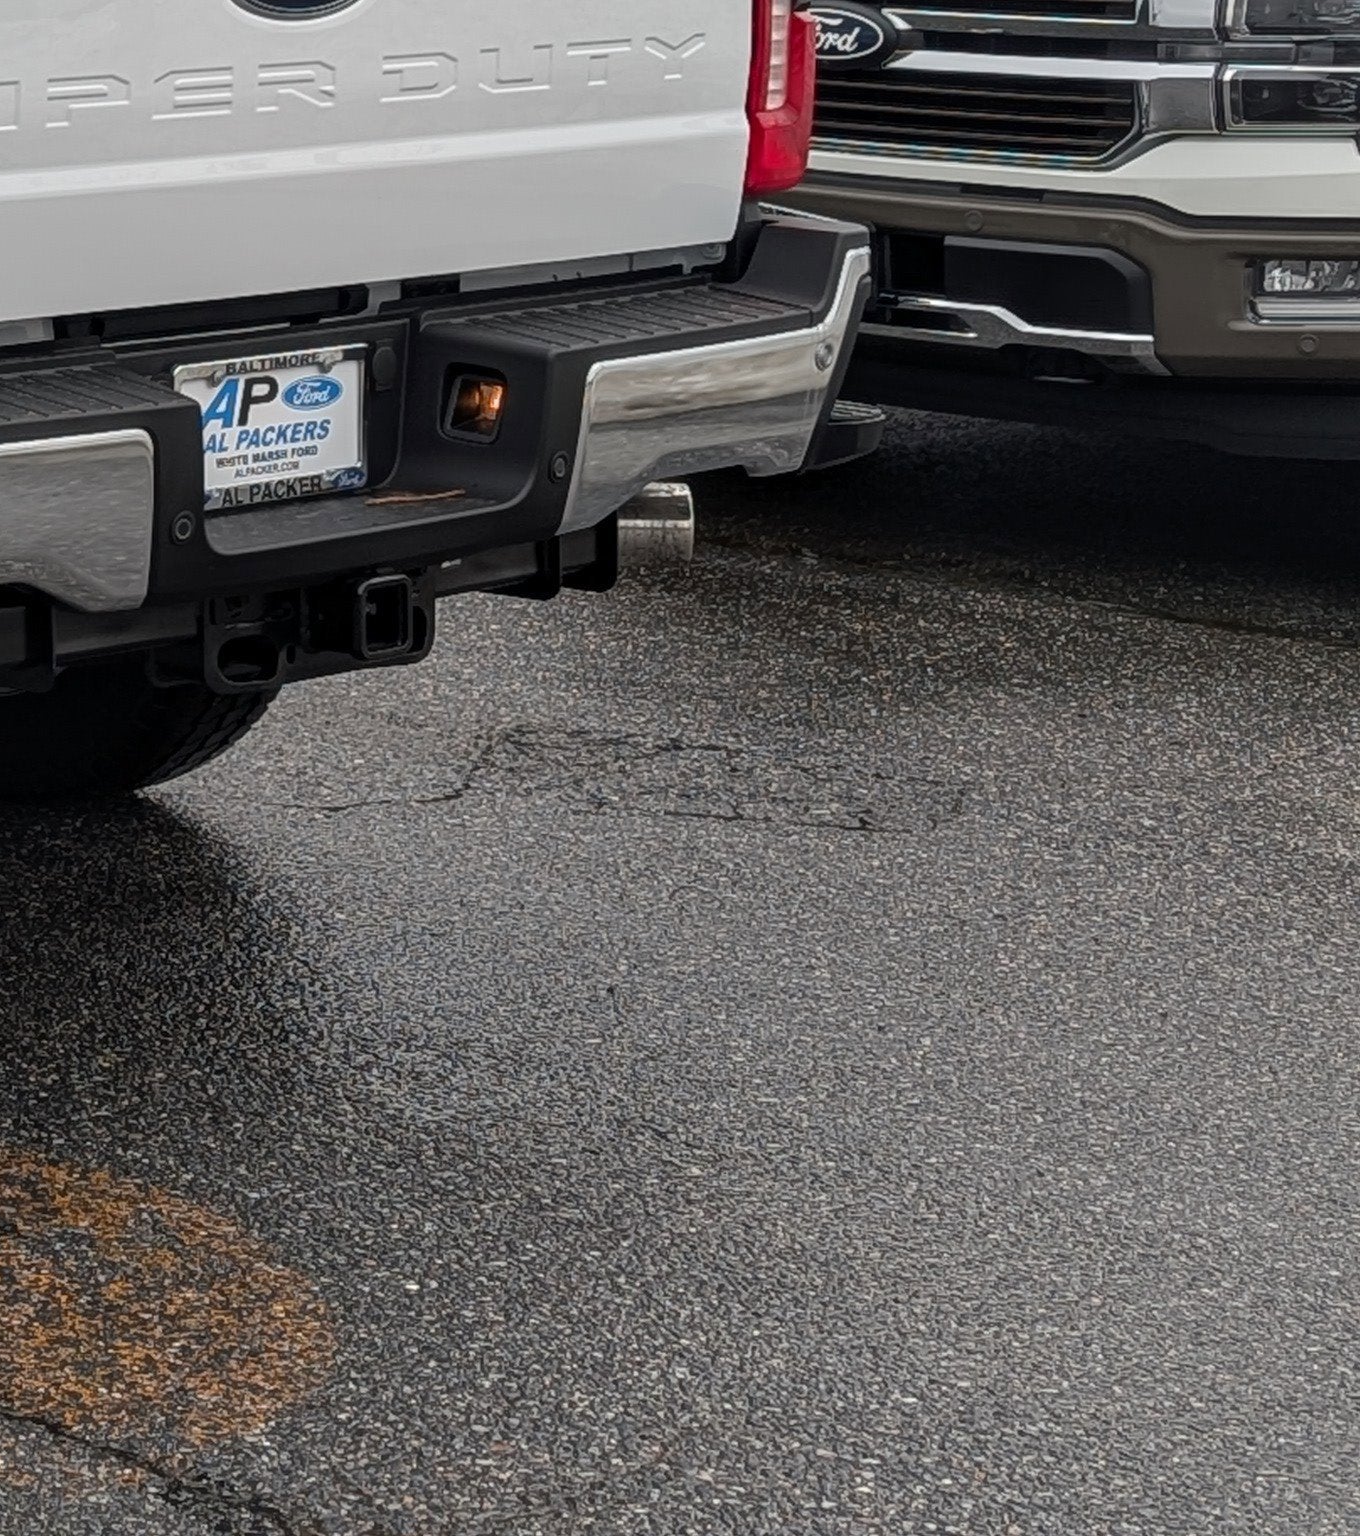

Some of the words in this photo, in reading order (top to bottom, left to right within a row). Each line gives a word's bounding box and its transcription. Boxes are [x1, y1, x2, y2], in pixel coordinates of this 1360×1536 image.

[379, 33, 706, 102] DUTY
[225, 352, 321, 375] BALTIMORE
[201, 375, 279, 429] AP
[292, 381, 331, 404] Ford
[203, 432, 229, 454] AL
[235, 419, 331, 450] PACKERS
[216, 454, 248, 468] WHITE
[252, 449, 287, 464] MARSH
[291, 445, 318, 459] FORD
[222, 486, 244, 507] AL
[249, 474, 323, 502] PACKER
